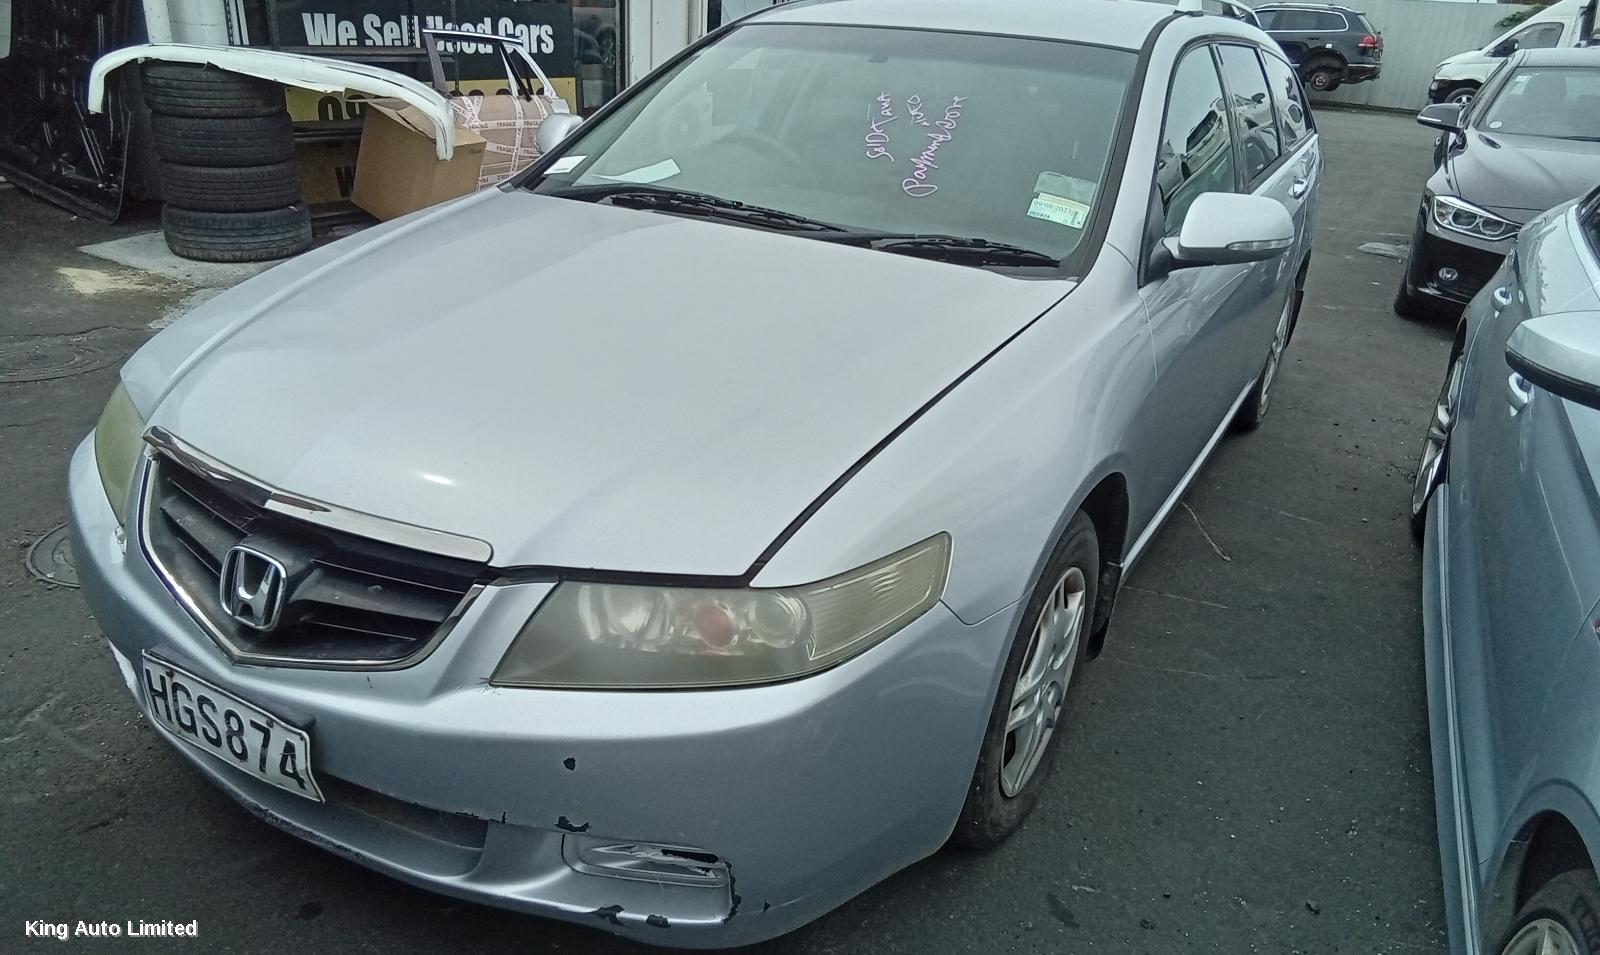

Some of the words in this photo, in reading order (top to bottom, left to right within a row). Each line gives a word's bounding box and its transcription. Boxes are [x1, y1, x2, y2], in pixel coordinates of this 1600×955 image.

[302, 12, 357, 46] We
[363, 14, 421, 48] Sell
[498, 17, 554, 54] Cars
[145, 668, 307, 790] HGS874
